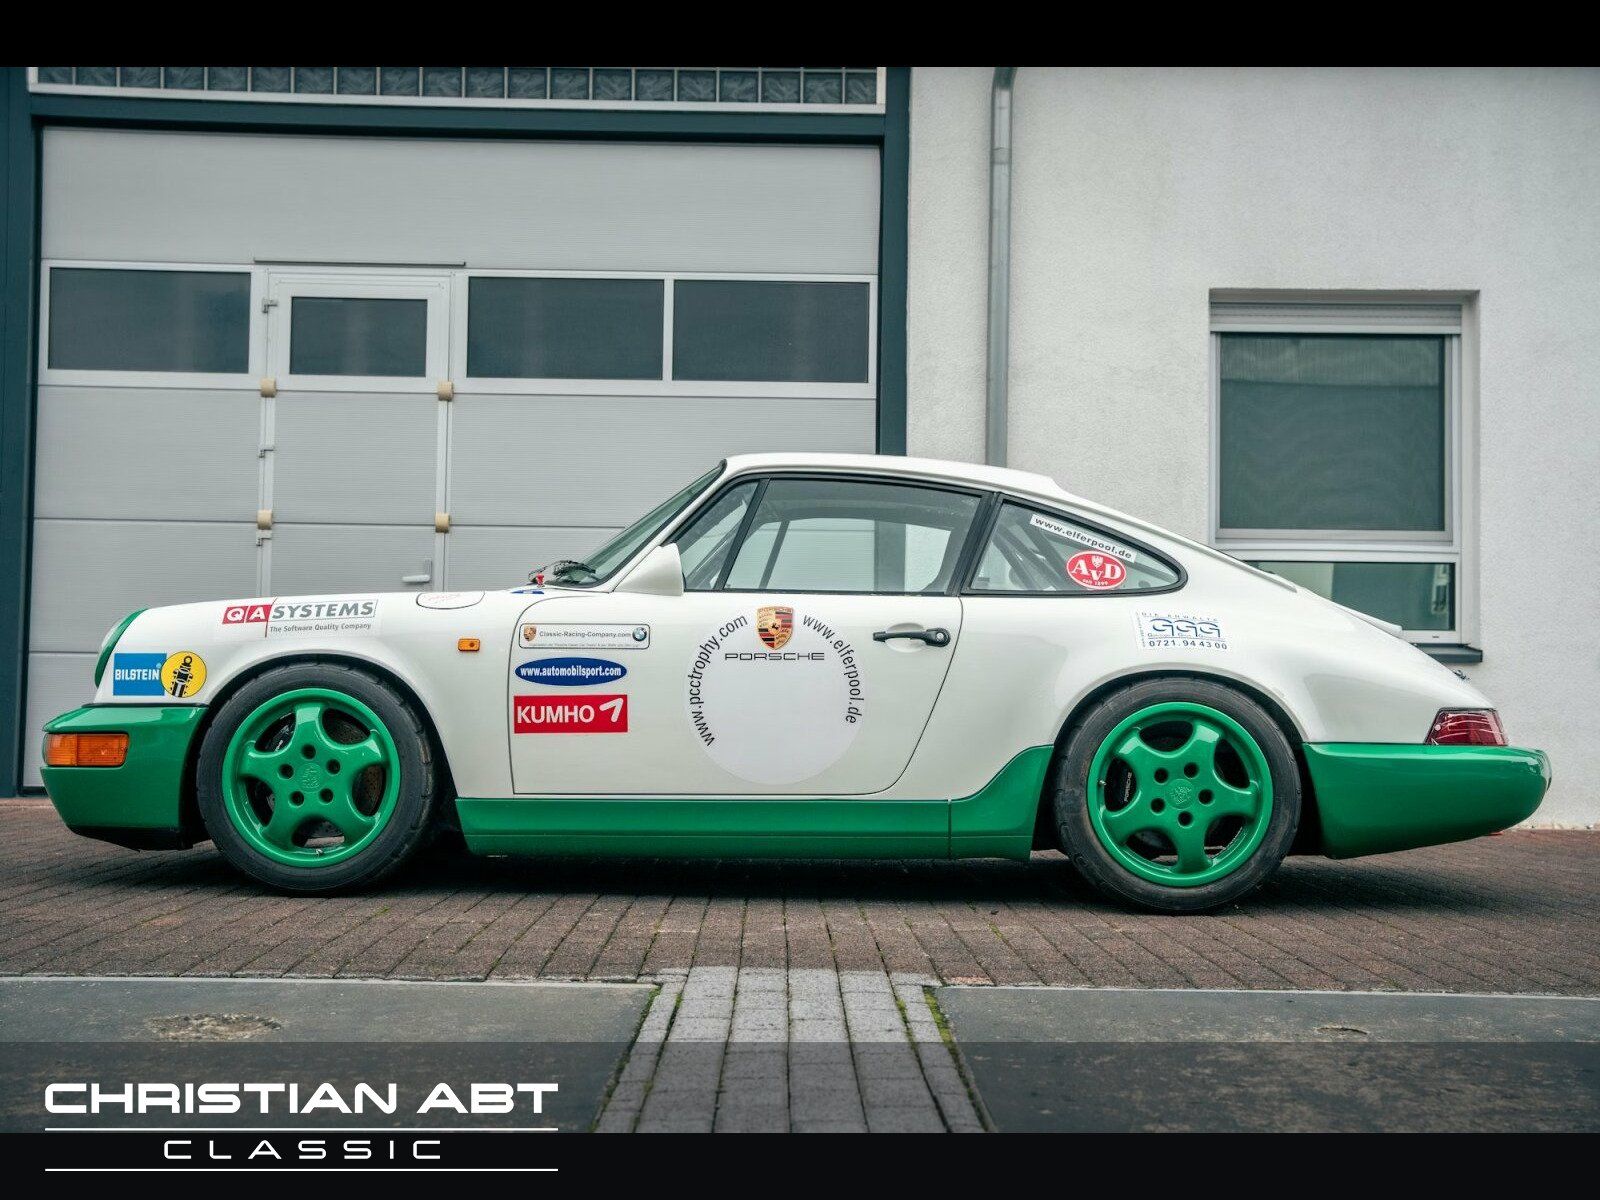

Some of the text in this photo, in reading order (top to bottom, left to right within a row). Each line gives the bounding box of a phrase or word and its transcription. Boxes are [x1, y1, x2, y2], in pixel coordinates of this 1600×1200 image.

[1035, 518, 1131, 559] www.elferpool.de
[272, 601, 374, 620] SYSTEMS
[539, 631, 632, 639] Classic-Racing-Company.com
[724, 652, 825, 661] PORSCHE
[114, 668, 160, 680] BILSTEIN
[520, 665, 622, 678] www.automobilsport.com
[803, 614, 865, 724] www.elferpool.de
[687, 615, 748, 747] www.pcctrophy.com
[516, 704, 595, 723] KUMHO
